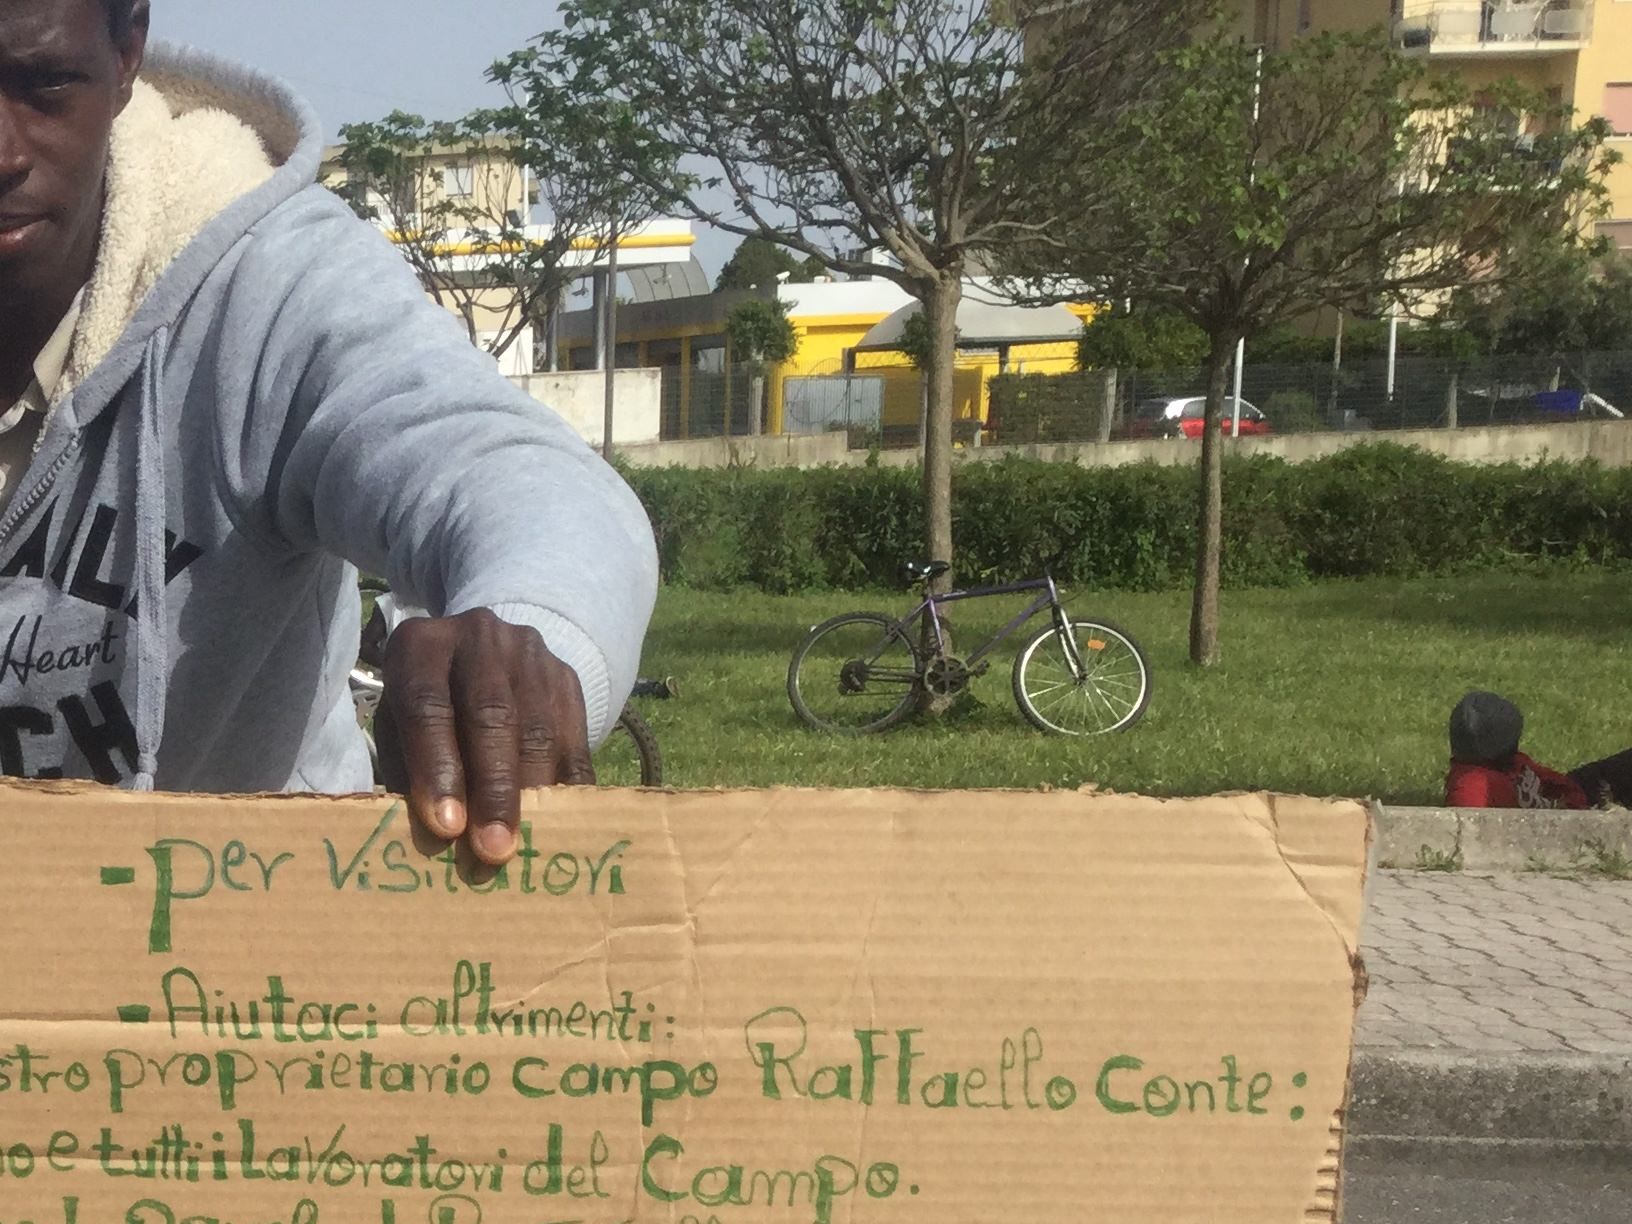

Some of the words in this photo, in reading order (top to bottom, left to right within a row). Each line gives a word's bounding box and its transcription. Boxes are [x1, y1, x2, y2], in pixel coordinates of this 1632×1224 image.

[161, 966, 378, 1042] Aiutaci
[106, 1047, 491, 1112] proprietario
[46, 1129, 80, 1173] e
[522, 1122, 611, 1198] del
